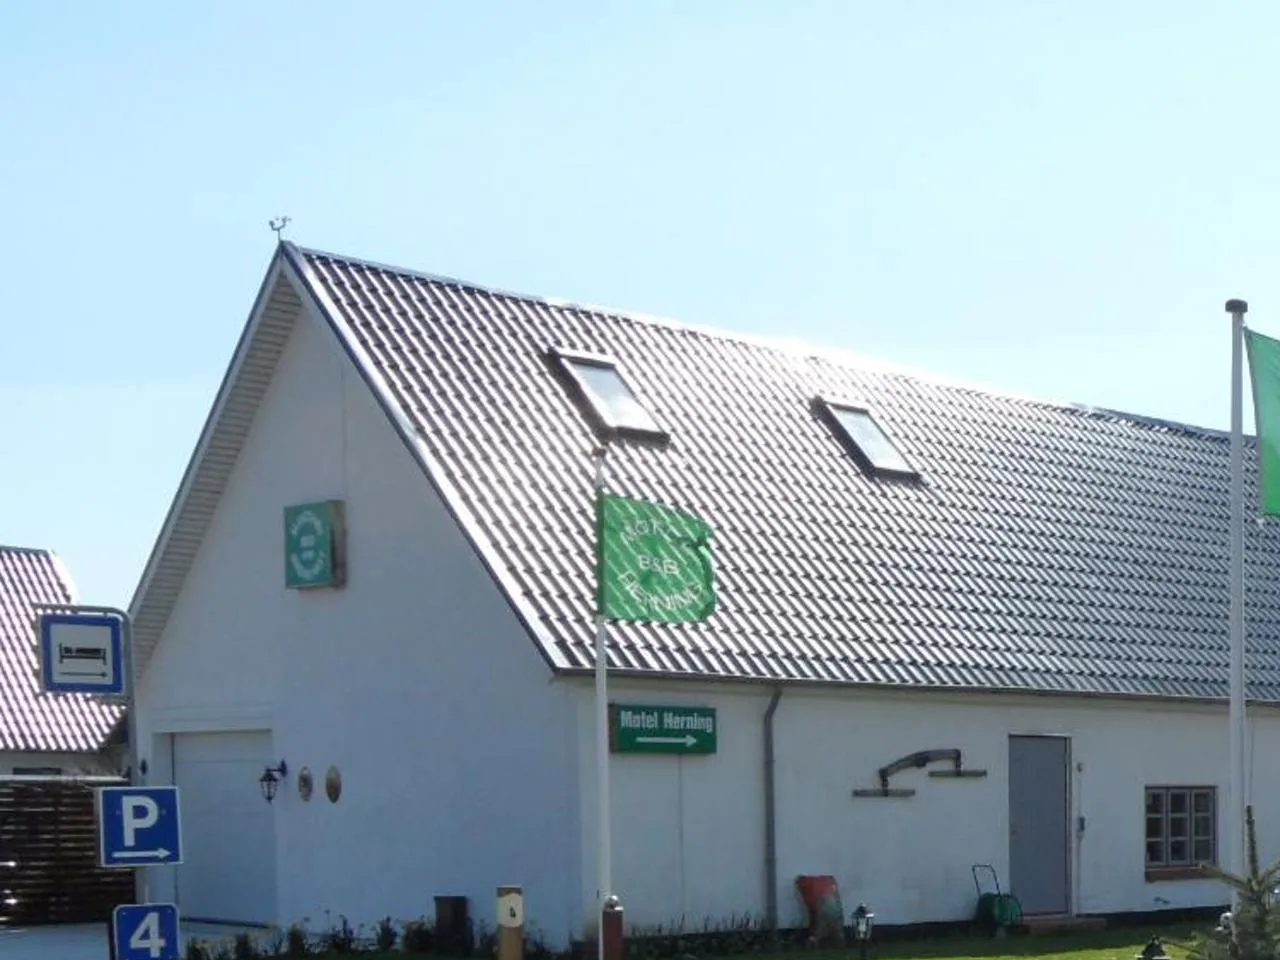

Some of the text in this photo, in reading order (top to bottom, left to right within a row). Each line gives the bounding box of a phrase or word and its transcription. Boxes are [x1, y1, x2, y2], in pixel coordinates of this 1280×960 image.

[621, 710, 713, 733] Motel Herning
[122, 795, 158, 847] P
[129, 911, 165, 958] 4
